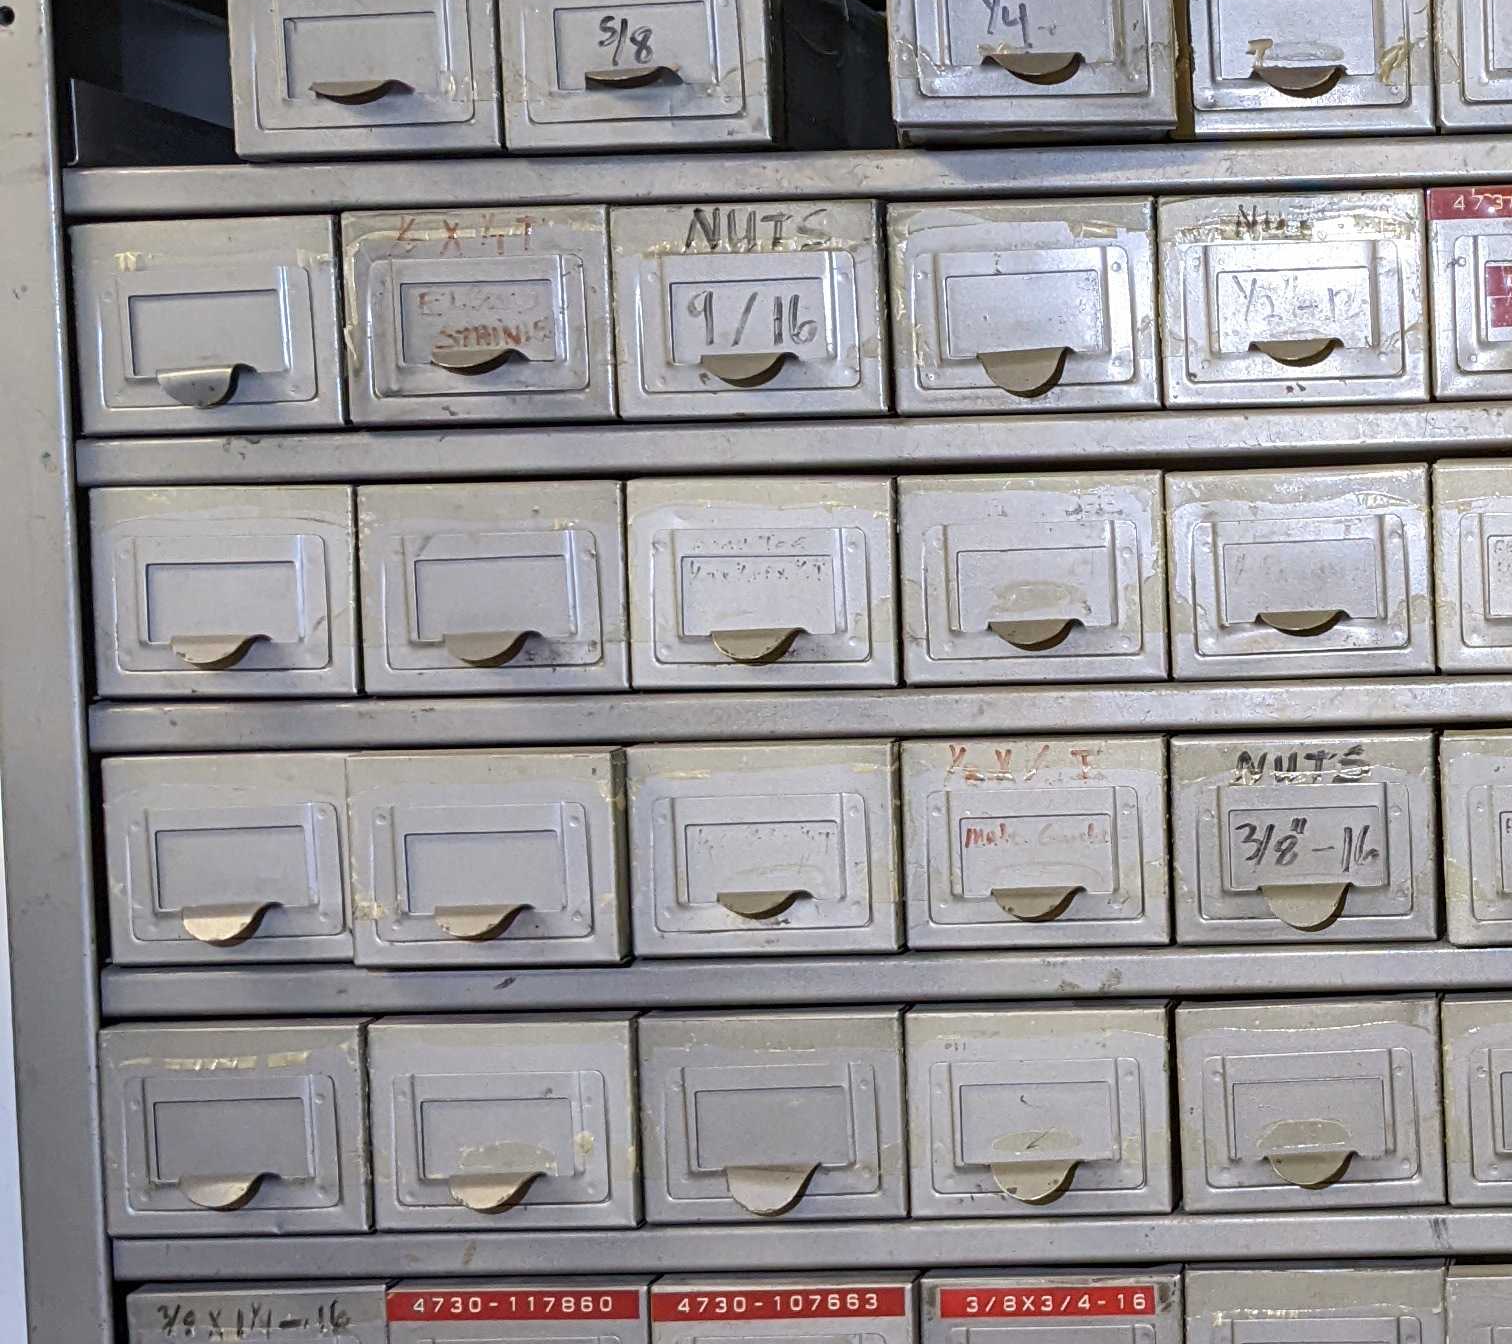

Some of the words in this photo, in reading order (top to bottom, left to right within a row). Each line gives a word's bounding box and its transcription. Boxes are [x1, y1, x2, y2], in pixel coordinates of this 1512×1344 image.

[685, 207, 828, 252] NUTS
[688, 292, 817, 346] 9/16
[1235, 747, 1371, 784] NUTS
[413, 1295, 613, 1313] 4730-117860
[678, 1293, 879, 1312] 4730-107663
[966, 1293, 1147, 1312] 3/8X3/4-16
